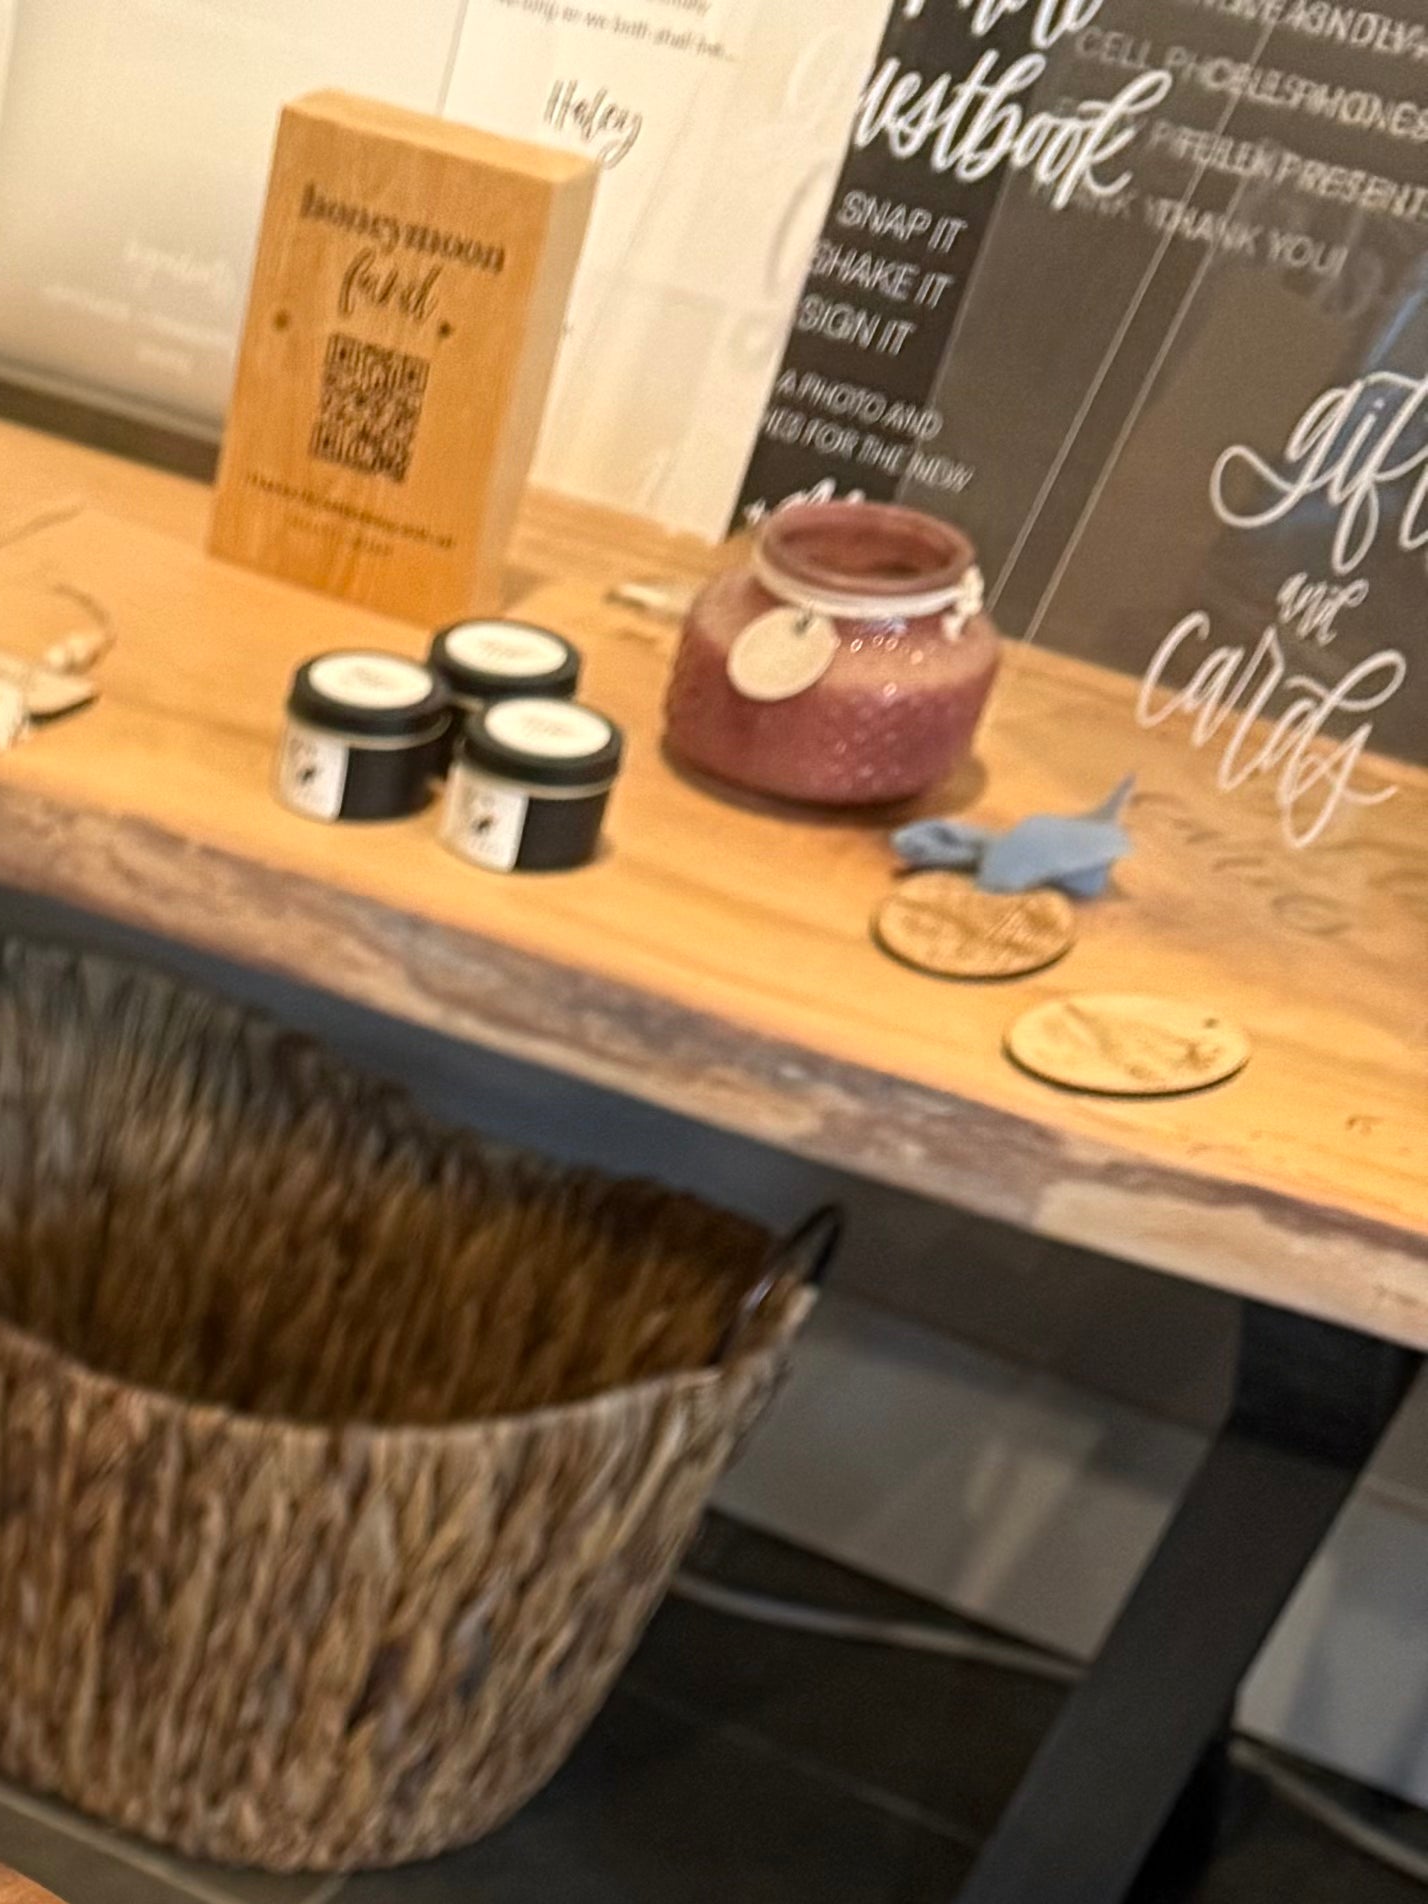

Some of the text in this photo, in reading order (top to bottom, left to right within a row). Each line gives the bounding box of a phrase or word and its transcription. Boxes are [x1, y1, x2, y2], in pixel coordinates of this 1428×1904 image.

[837, 190, 969, 254] SNAP IT
[914, 272, 956, 309] IT
[797, 293, 918, 356] SIGN IT
[1134, 588, 1408, 849] cards
